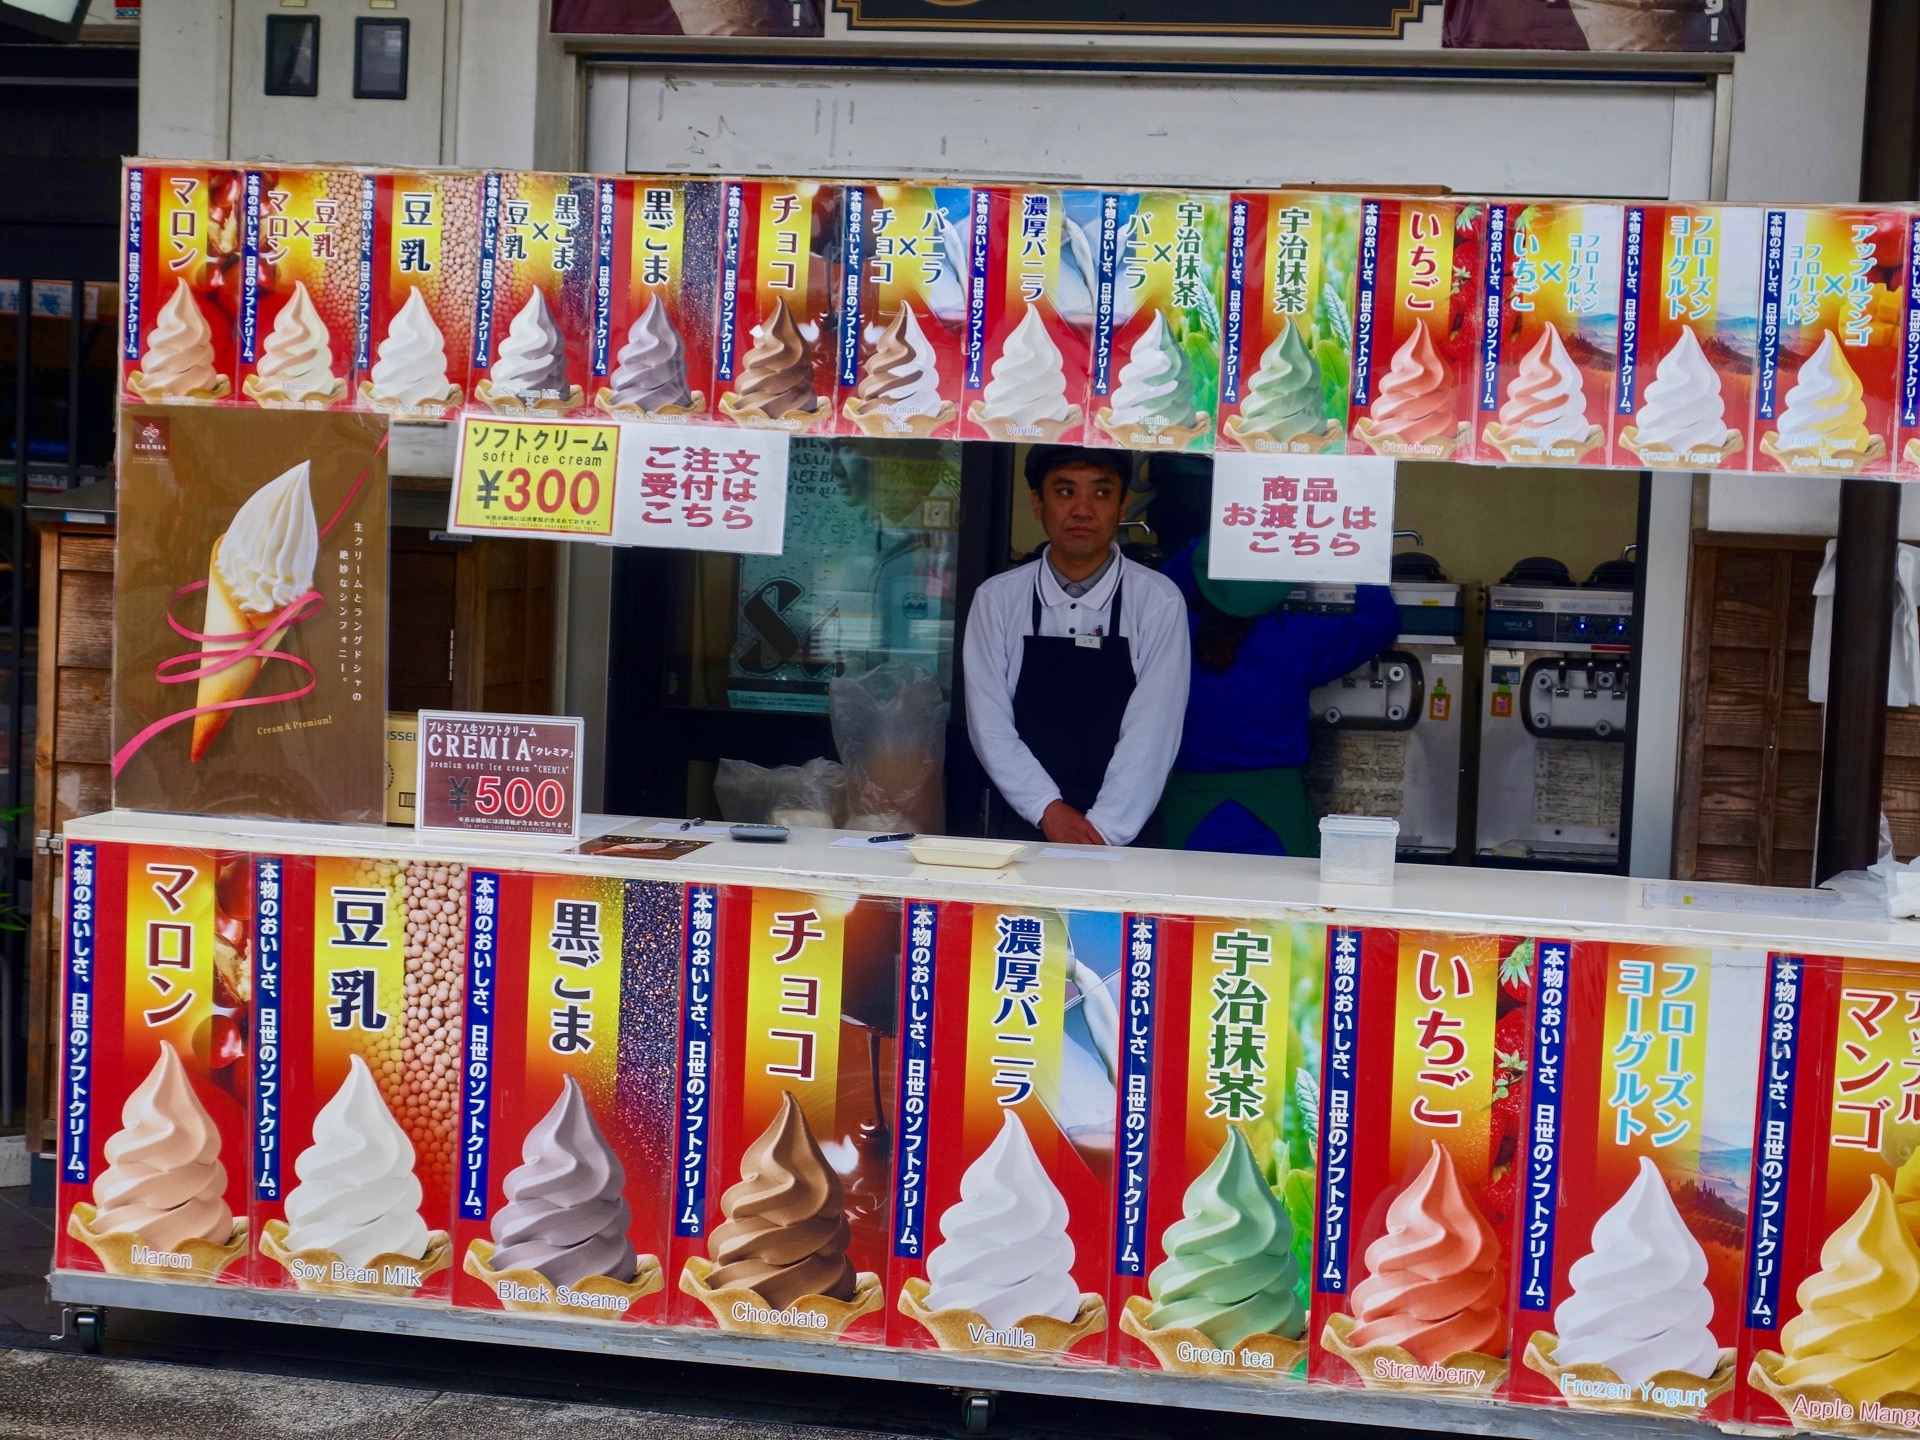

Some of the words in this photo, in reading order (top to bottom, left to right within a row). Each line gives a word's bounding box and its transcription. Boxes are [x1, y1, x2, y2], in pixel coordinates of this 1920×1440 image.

[169, 176, 199, 269] マロン
[266, 190, 291, 265] マロン
[312, 199, 337, 259] 豆乳
[398, 191, 433, 273] 豆乳
[504, 200, 529, 261] 豆乳
[553, 194, 579, 271] 黒ごま
[642, 188, 674, 285] 黒ごま
[768, 193, 801, 290] チョコ
[870, 207, 896, 284] チョコ
[921, 206, 949, 285] バニラ
[1020, 195, 1049, 301] 濃厚バニラ
[1125, 213, 1152, 290] バニラ
[1171, 201, 1205, 308] 宇治抹茶
[1274, 207, 1310, 314] 宇治抹茶
[1406, 211, 1441, 310] いちご
[1512, 232, 1539, 311] いちご
[1566, 234, 1585, 314] ヨーグルト
[1583, 233, 1601, 313] フローズン
[1667, 215, 1690, 319] ヨーグルト
[1690, 216, 1715, 320] フローズン
[1785, 244, 1804, 325] ヨーグルト
[1801, 244, 1823, 325] フローズン
[1845, 224, 1877, 347] アップルマンゴ
[473, 427, 609, 453] ソフトクリーム
[748, 416, 802, 428] Chocolate
[878, 404, 921, 414] Chocolate
[883, 422, 913, 432] Vanilla
[1005, 424, 1043, 437] Vanilla
[1130, 433, 1156, 444] Green
[1158, 434, 1174, 444] tea
[1138, 415, 1169, 425] Vanilla
[1255, 439, 1288, 451] Green
[1291, 440, 1310, 453] tea
[1382, 440, 1444, 456] Strawberry
[476, 467, 600, 516] ¥300
[482, 451, 515, 463] soft
[527, 452, 549, 464] ice
[559, 455, 602, 466] cream
[641, 471, 758, 502] 受付は
[645, 445, 761, 477] ご注文
[1262, 475, 1338, 503] 商品
[1639, 447, 1681, 461] Frozen
[1684, 448, 1722, 464] Yogurt
[641, 500, 754, 531] こちら
[1222, 502, 1378, 530] お渡しは
[1249, 531, 1361, 557] こちら
[352, 521, 363, 701] 生クリームとラングドシャの
[256, 724, 284, 736] Cream
[292, 714, 333, 731] Premium!
[427, 734, 532, 762] CREMIA
[428, 721, 537, 737] プレミアム生ソフトクリーム
[430, 761, 462, 770] premium
[466, 762, 484, 771] soft
[489, 763, 503, 772] ice
[506, 764, 530, 773] cream
[143, 862, 198, 1028] マロン
[328, 886, 389, 1031] 豆乳
[548, 898, 603, 1055] 黒ごま
[67, 848, 93, 1180] 本物のおいしさ、日世のソフトクリーム。
[258, 862, 279, 1198] 本物のおいしさ、日世のソフトクリーム。
[766, 908, 825, 1081] チョコ
[991, 914, 1045, 1107] 濃厚バニラ
[1204, 928, 1272, 1122] 宇治抹茶
[464, 877, 494, 1217] 本物のおいしさ、日世のソフトクリーム。
[680, 892, 714, 1235] 本物のおいしさ、日世のソフトクリーム。
[1409, 949, 1473, 1129] いちご
[1608, 959, 1655, 1147] ヨーグルト
[1650, 962, 1698, 1149] フローズン
[1831, 987, 1898, 1153] マンゴ
[899, 908, 934, 1256] 本物のおいしさ、日世のソフトクリーム。
[1120, 922, 1153, 1272] 本物のおいしさ、日世のソフトクリーム。
[1322, 936, 1357, 1290] 本物のおいしさ、日世のソフトクリーム。
[1525, 948, 1566, 1307] 本物のおいしさ、日世のソフトクリーム。
[1751, 962, 1798, 1326] 本物のおいしさ、日世のソフトクリーム。
[130, 1245, 193, 1269] Marron
[291, 1259, 327, 1283] Soy
[331, 1263, 379, 1284] Bean
[383, 1266, 422, 1287] Milk
[497, 1280, 551, 1305] Black
[556, 1286, 630, 1312] Sesame
[732, 1302, 829, 1329] Chocolate
[968, 1323, 1036, 1349] Vanilla
[1177, 1341, 1236, 1367] Green
[1240, 1346, 1275, 1369] tea
[1373, 1357, 1486, 1388] Strawberry
[1560, 1373, 1631, 1401] Frozen
[1638, 1379, 1708, 1409] Yogurt
[1792, 1394, 1854, 1420] Apple
